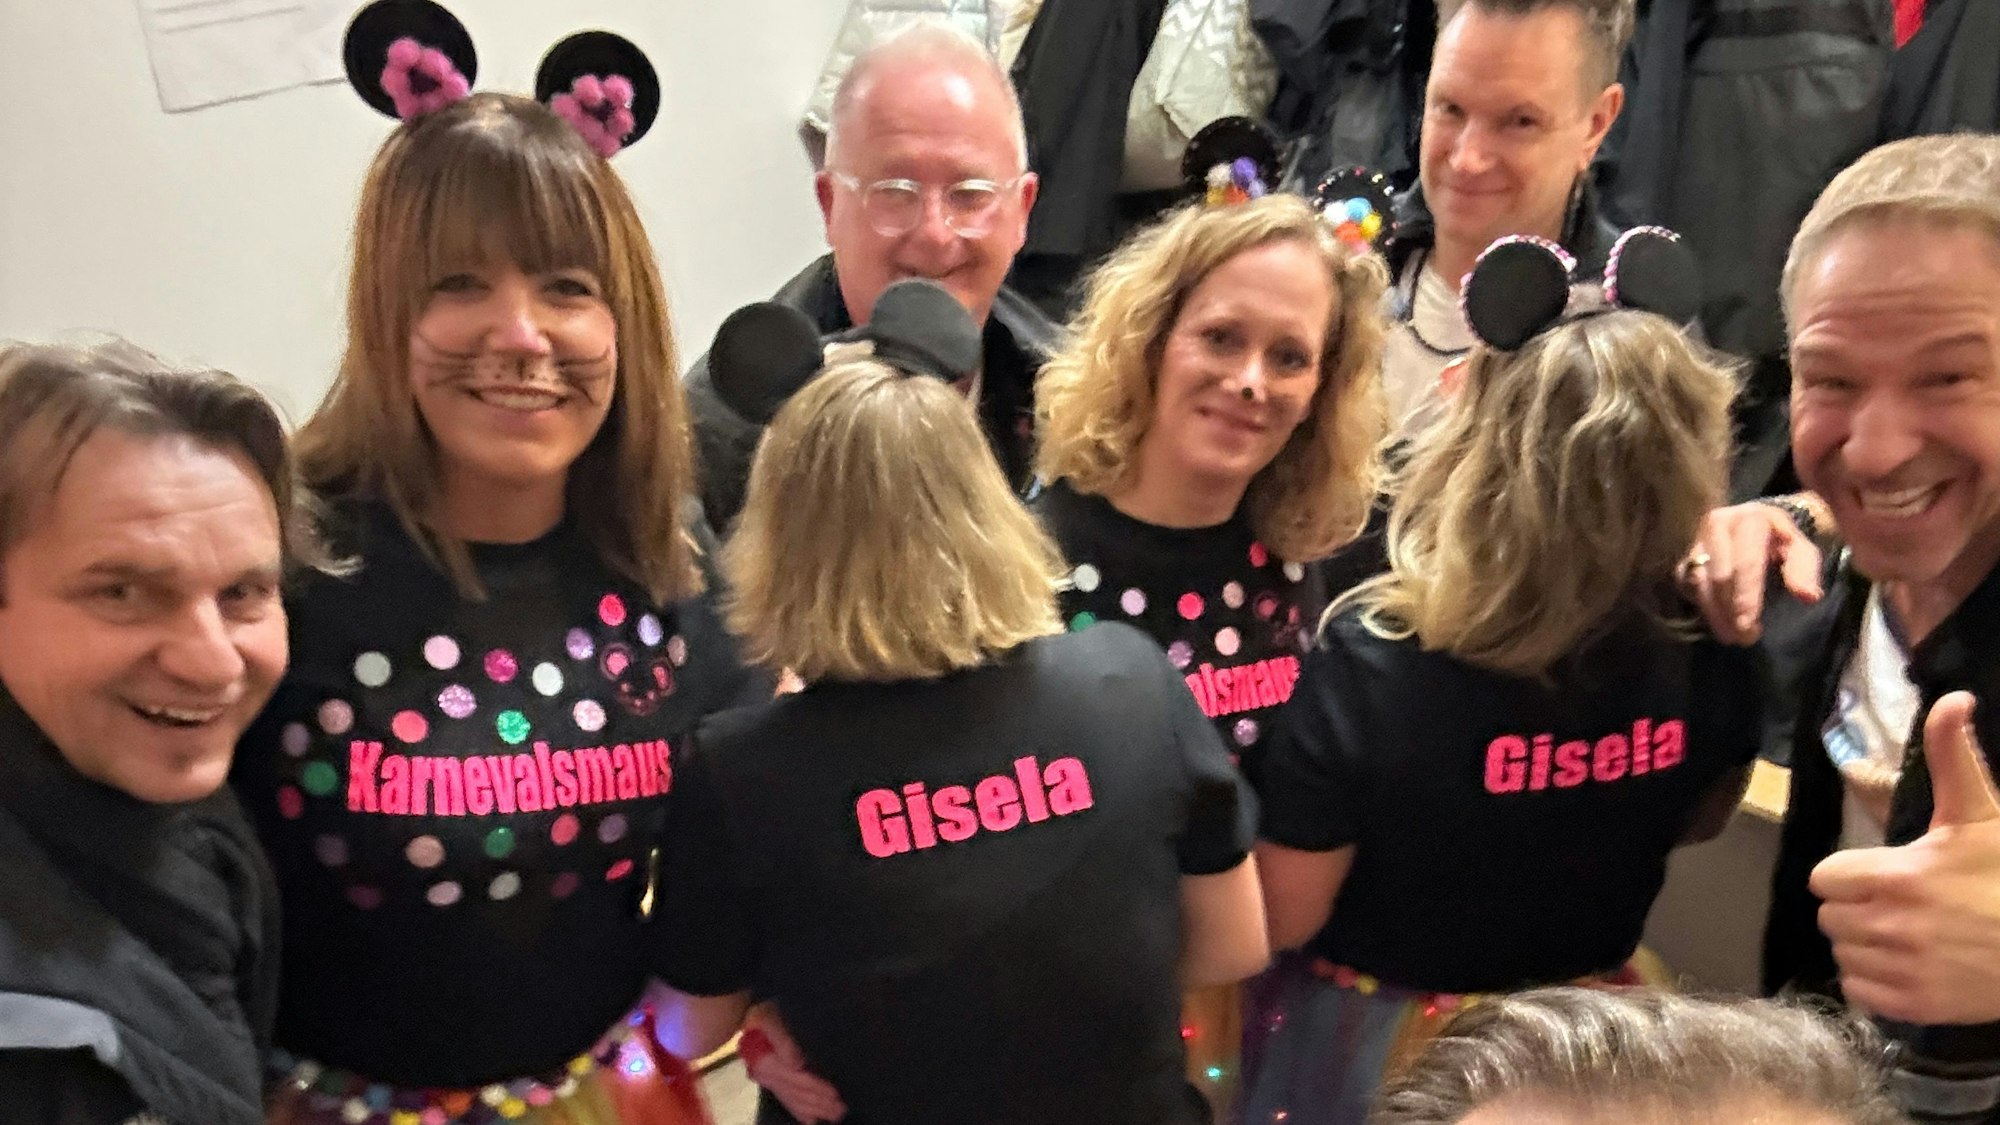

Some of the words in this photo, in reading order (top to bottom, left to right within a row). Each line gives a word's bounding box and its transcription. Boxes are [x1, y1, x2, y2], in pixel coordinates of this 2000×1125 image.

[346, 738, 673, 817] Karnevalsmaus
[1484, 717, 1686, 795] Gisela
[856, 755, 1094, 858] Gisela
